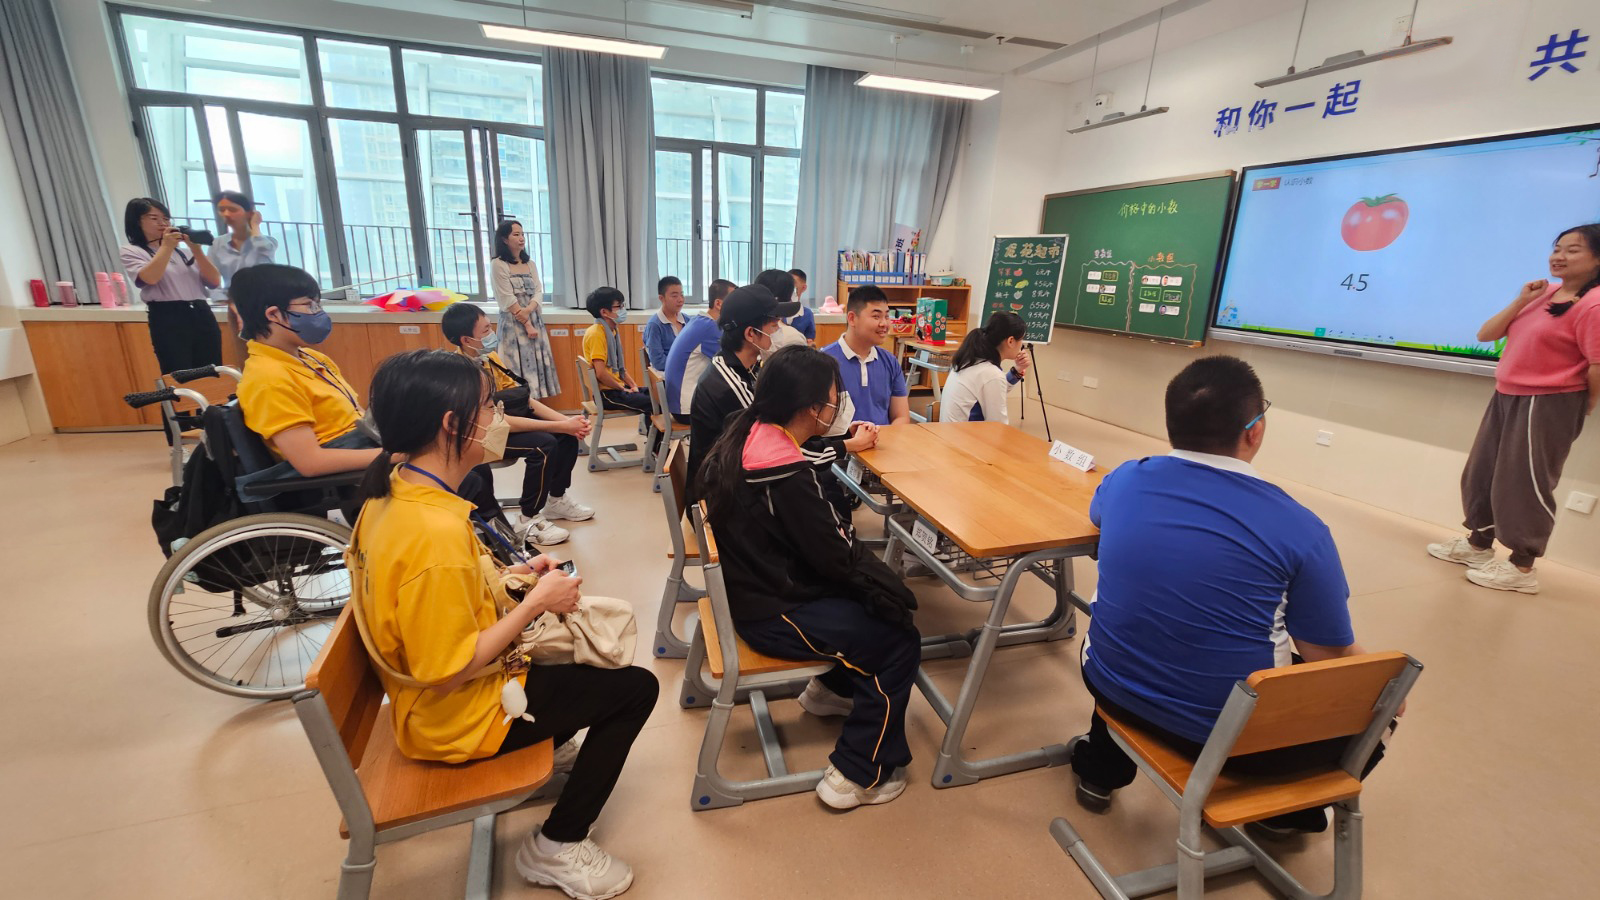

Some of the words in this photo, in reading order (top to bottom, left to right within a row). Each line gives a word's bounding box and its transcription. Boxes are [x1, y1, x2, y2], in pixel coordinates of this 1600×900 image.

[1528, 29, 1589, 81] 共
[1214, 80, 1361, 137] 和你一起
[1117, 199, 1178, 218] 价格中的小数
[1148, 252, 1175, 262] 小数组
[1340, 273, 1370, 292] 4.5
[1053, 444, 1088, 468] 小数组
